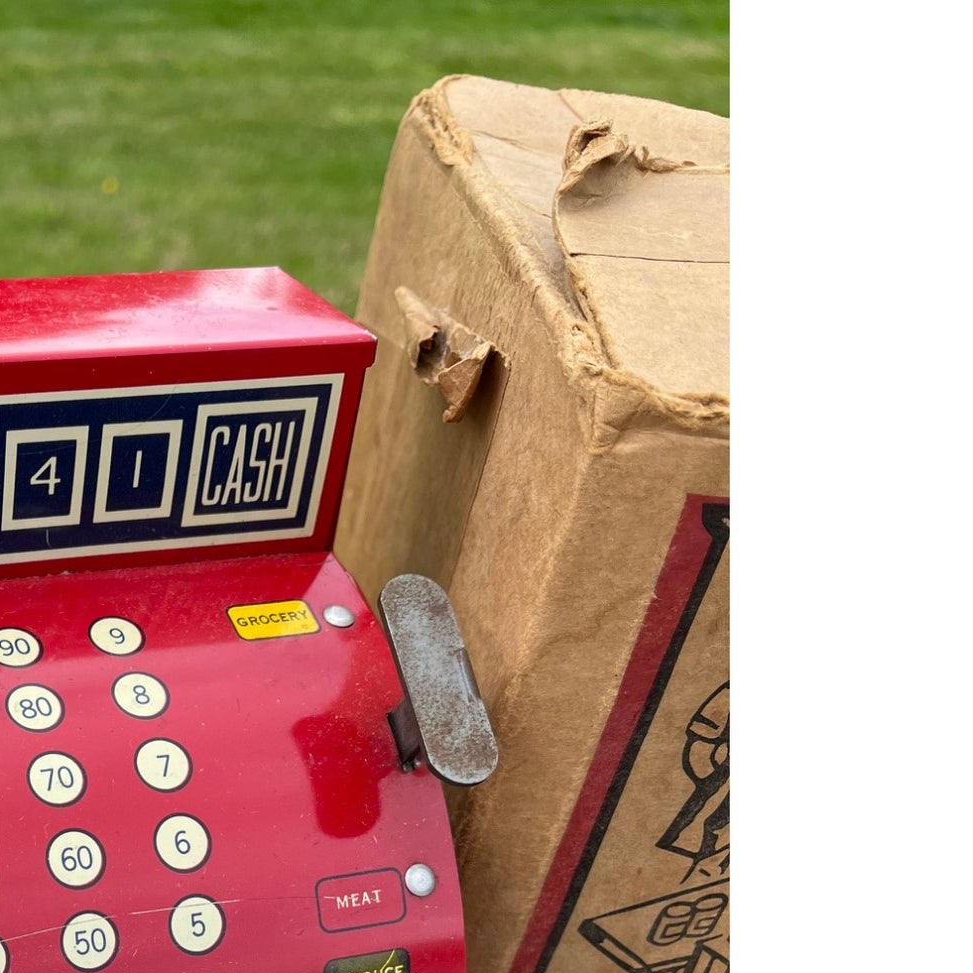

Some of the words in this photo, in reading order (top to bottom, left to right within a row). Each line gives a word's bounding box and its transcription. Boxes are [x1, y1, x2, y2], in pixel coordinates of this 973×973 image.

[30, 456, 58, 496] 4
[202, 420, 296, 505] CASH
[108, 627, 127, 645] 9
[236, 609, 308, 628] GROCERY
[19, 696, 54, 719] 80
[132, 684, 151, 705] 8
[39, 765, 75, 792] 70
[155, 754, 171, 778] 7
[60, 845, 94, 872] 60
[174, 830, 192, 855] 6
[335, 888, 384, 909] MEAT
[74, 927, 108, 956] 50
[190, 912, 206, 937] 5
